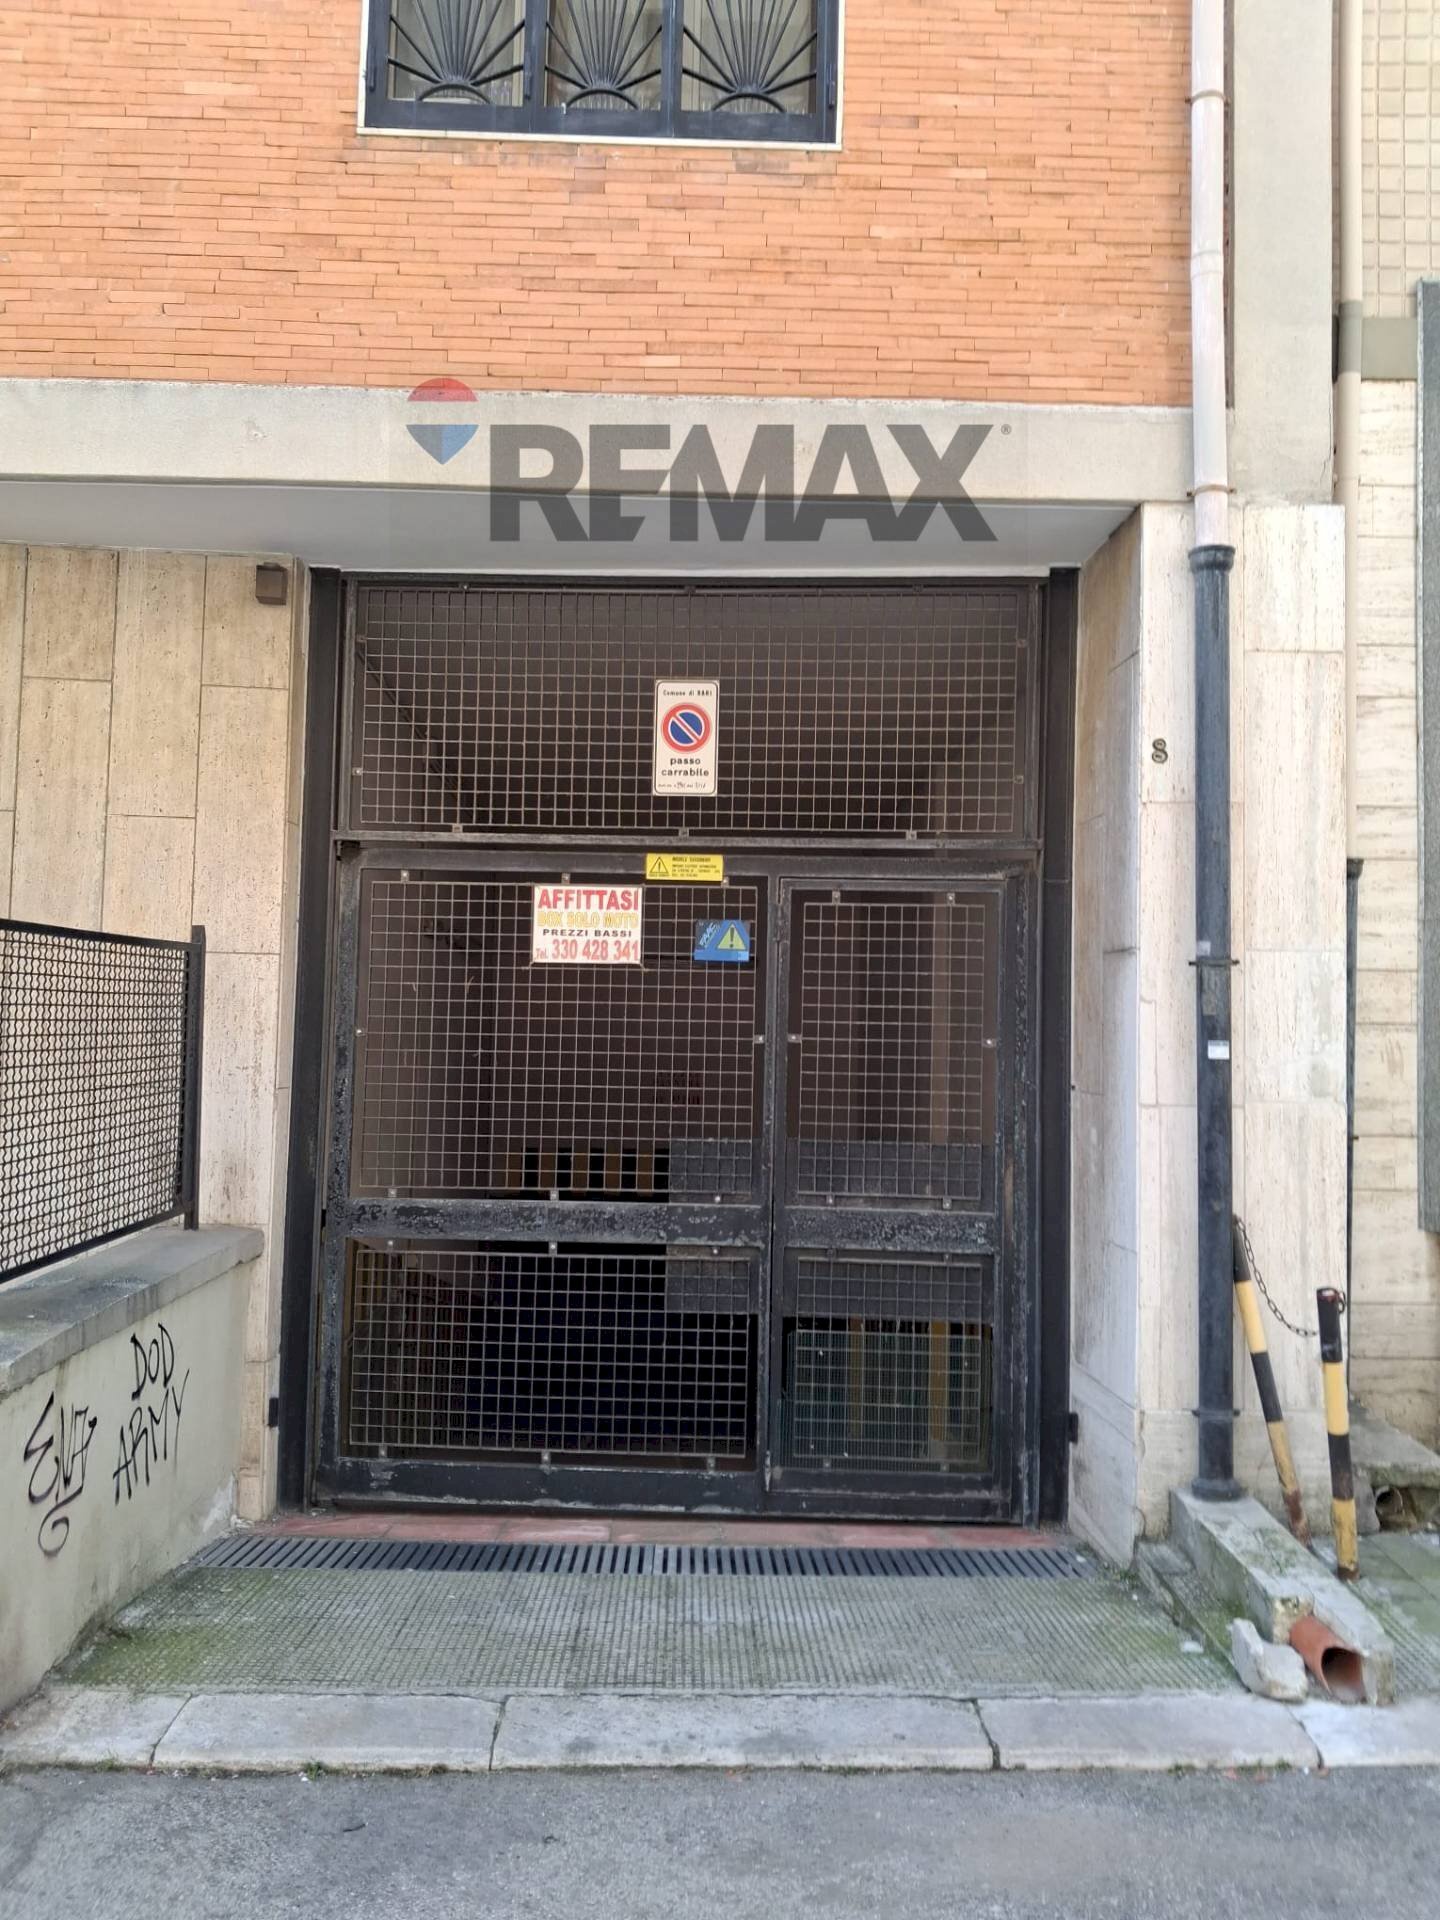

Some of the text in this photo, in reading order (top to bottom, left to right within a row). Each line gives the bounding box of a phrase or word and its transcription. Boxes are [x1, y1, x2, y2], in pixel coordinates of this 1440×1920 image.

[1152, 738, 1168, 764] 8
[670, 757, 701, 766] passo
[661, 767, 710, 777] carrabile
[538, 889, 639, 911] AFFITTASI
[538, 911, 639, 929] BOX SOLO MOTO
[542, 928, 632, 938] PREZZI BASSI
[552, 938, 578, 960] 330
[582, 939, 609, 961] 428
[613, 940, 639, 962] 341
[113, 1368, 190, 1506] ARMY
